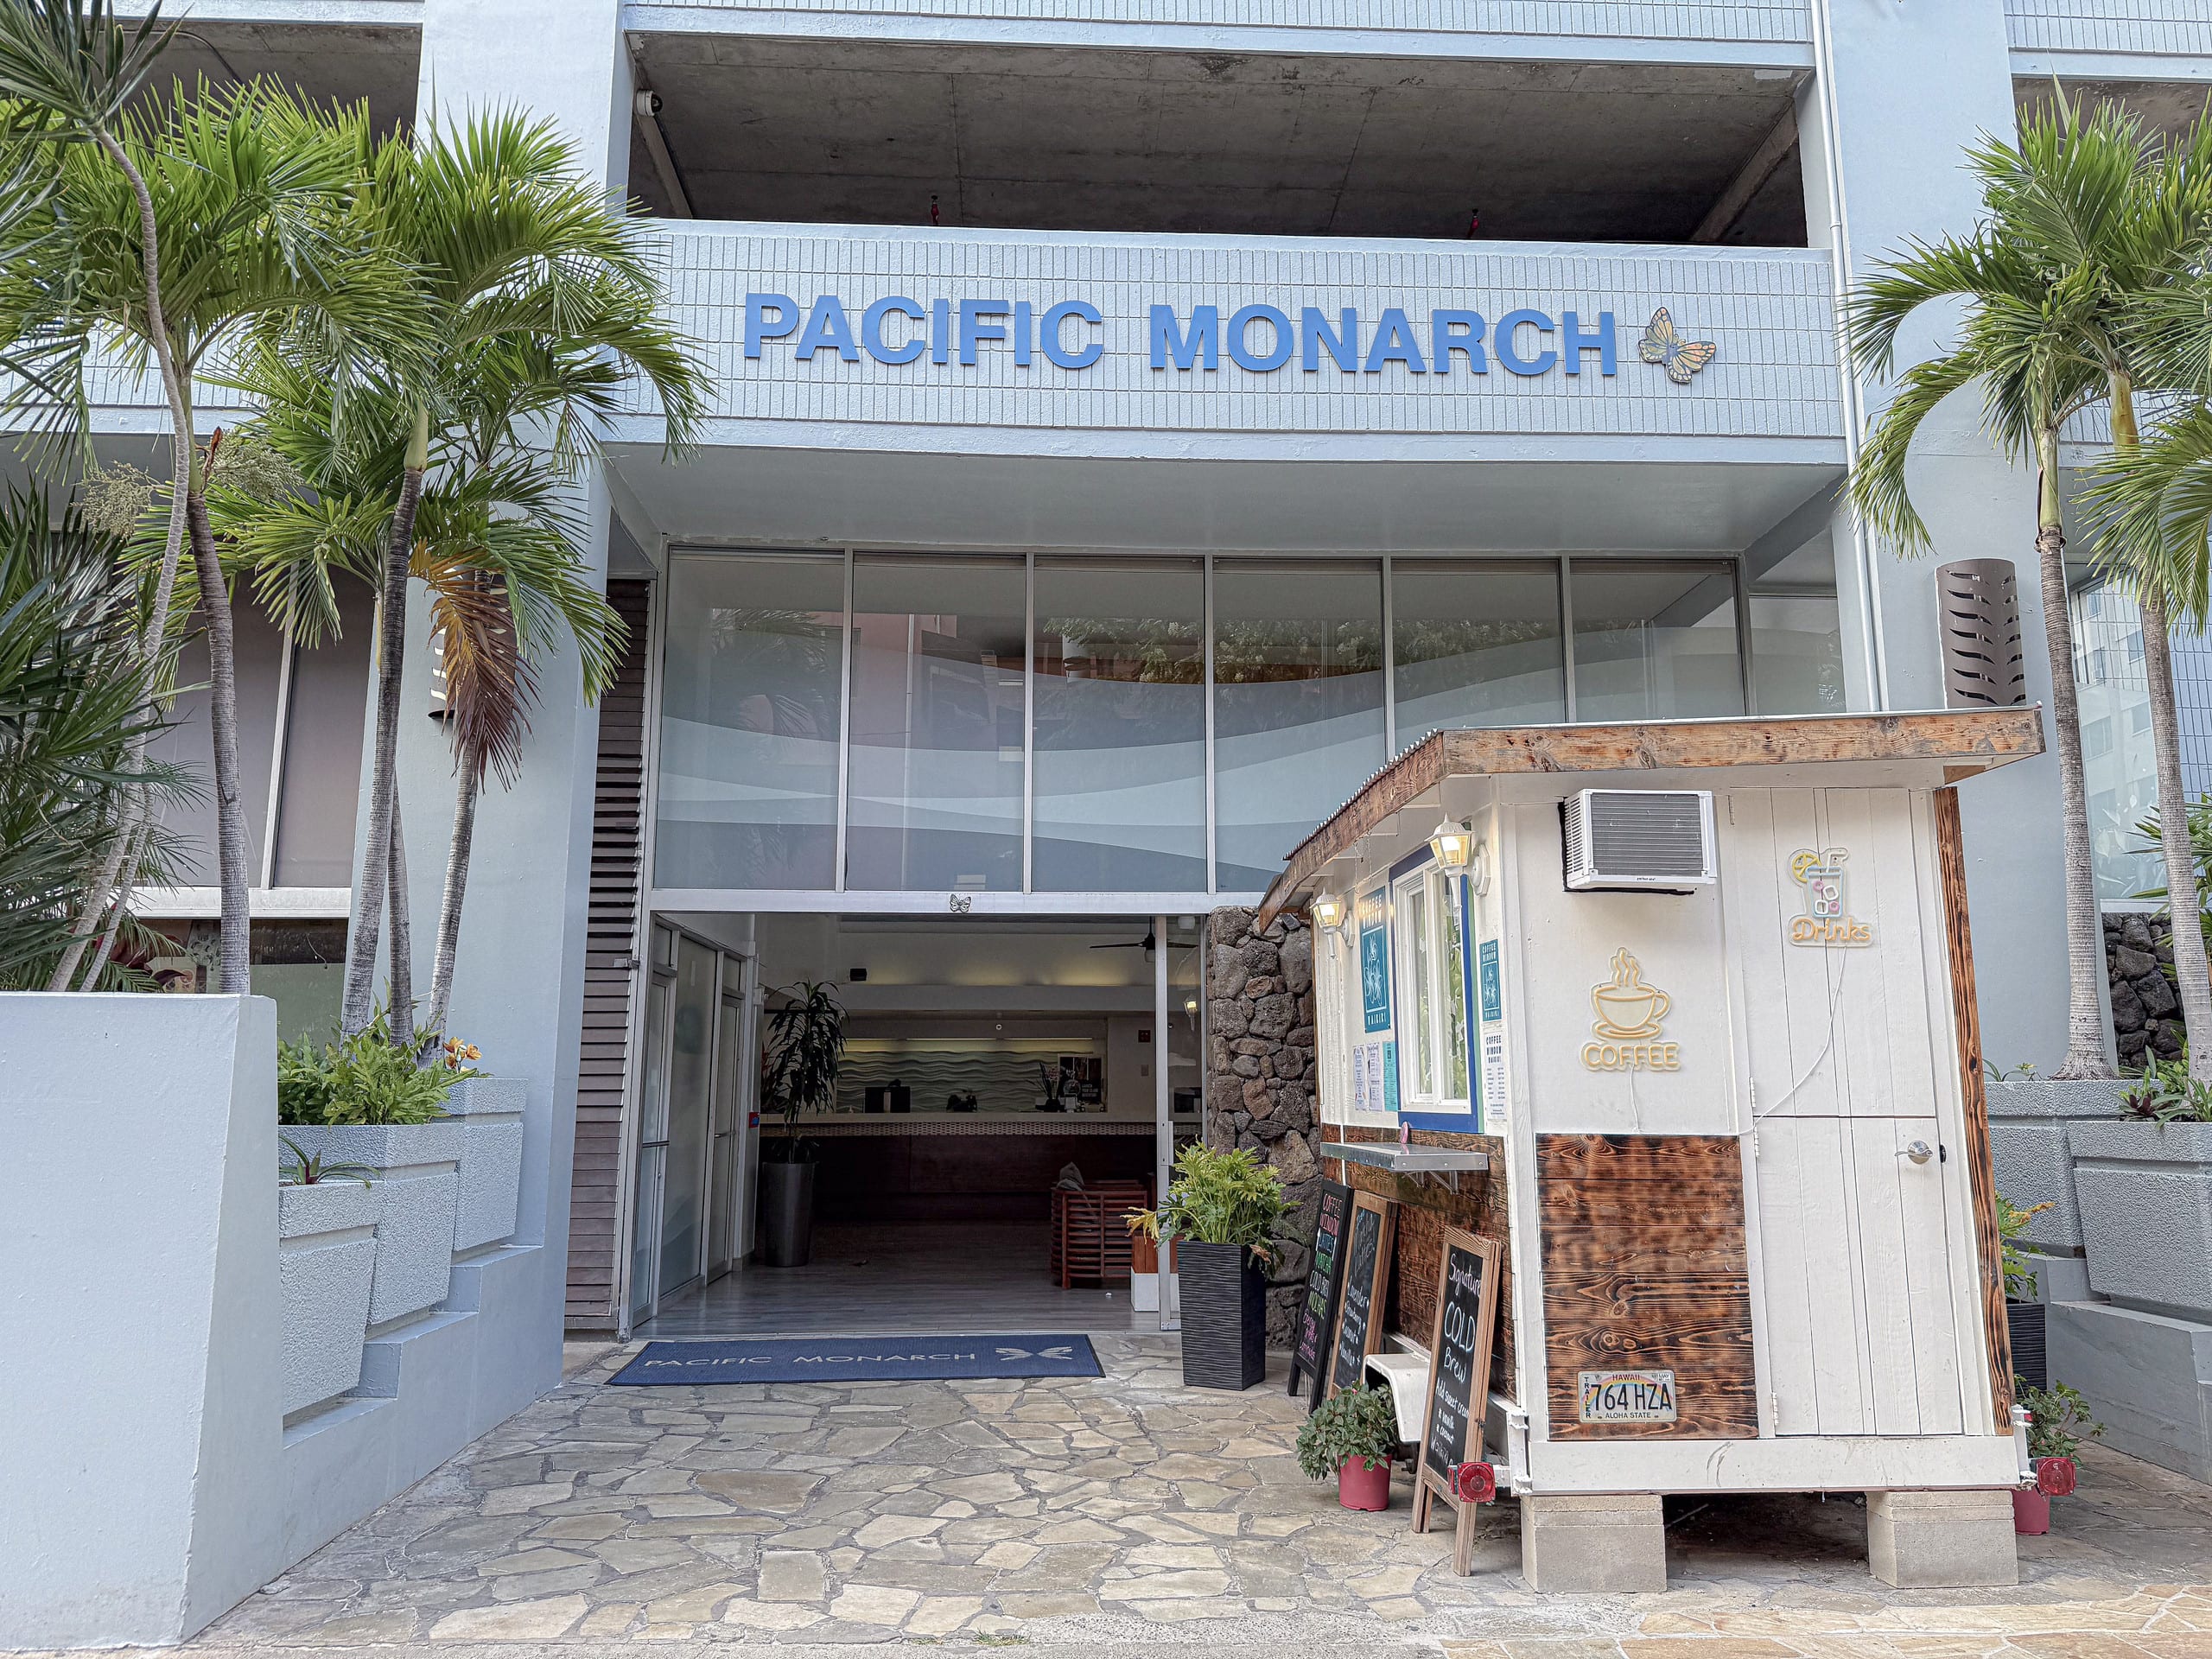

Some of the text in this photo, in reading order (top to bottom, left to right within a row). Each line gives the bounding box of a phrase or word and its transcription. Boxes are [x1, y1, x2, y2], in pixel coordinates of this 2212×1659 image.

[744, 292, 1617, 377] PACIFIC MONARCH
[1792, 917, 1871, 941] Drinks
[1584, 1046, 1679, 1066] COFFEE
[1449, 1254, 1482, 1297] Signature
[1444, 1301, 1476, 1353] COLD
[644, 1353, 976, 1367] PACIFIC MONARCH
[1444, 1346, 1467, 1383] Brew
